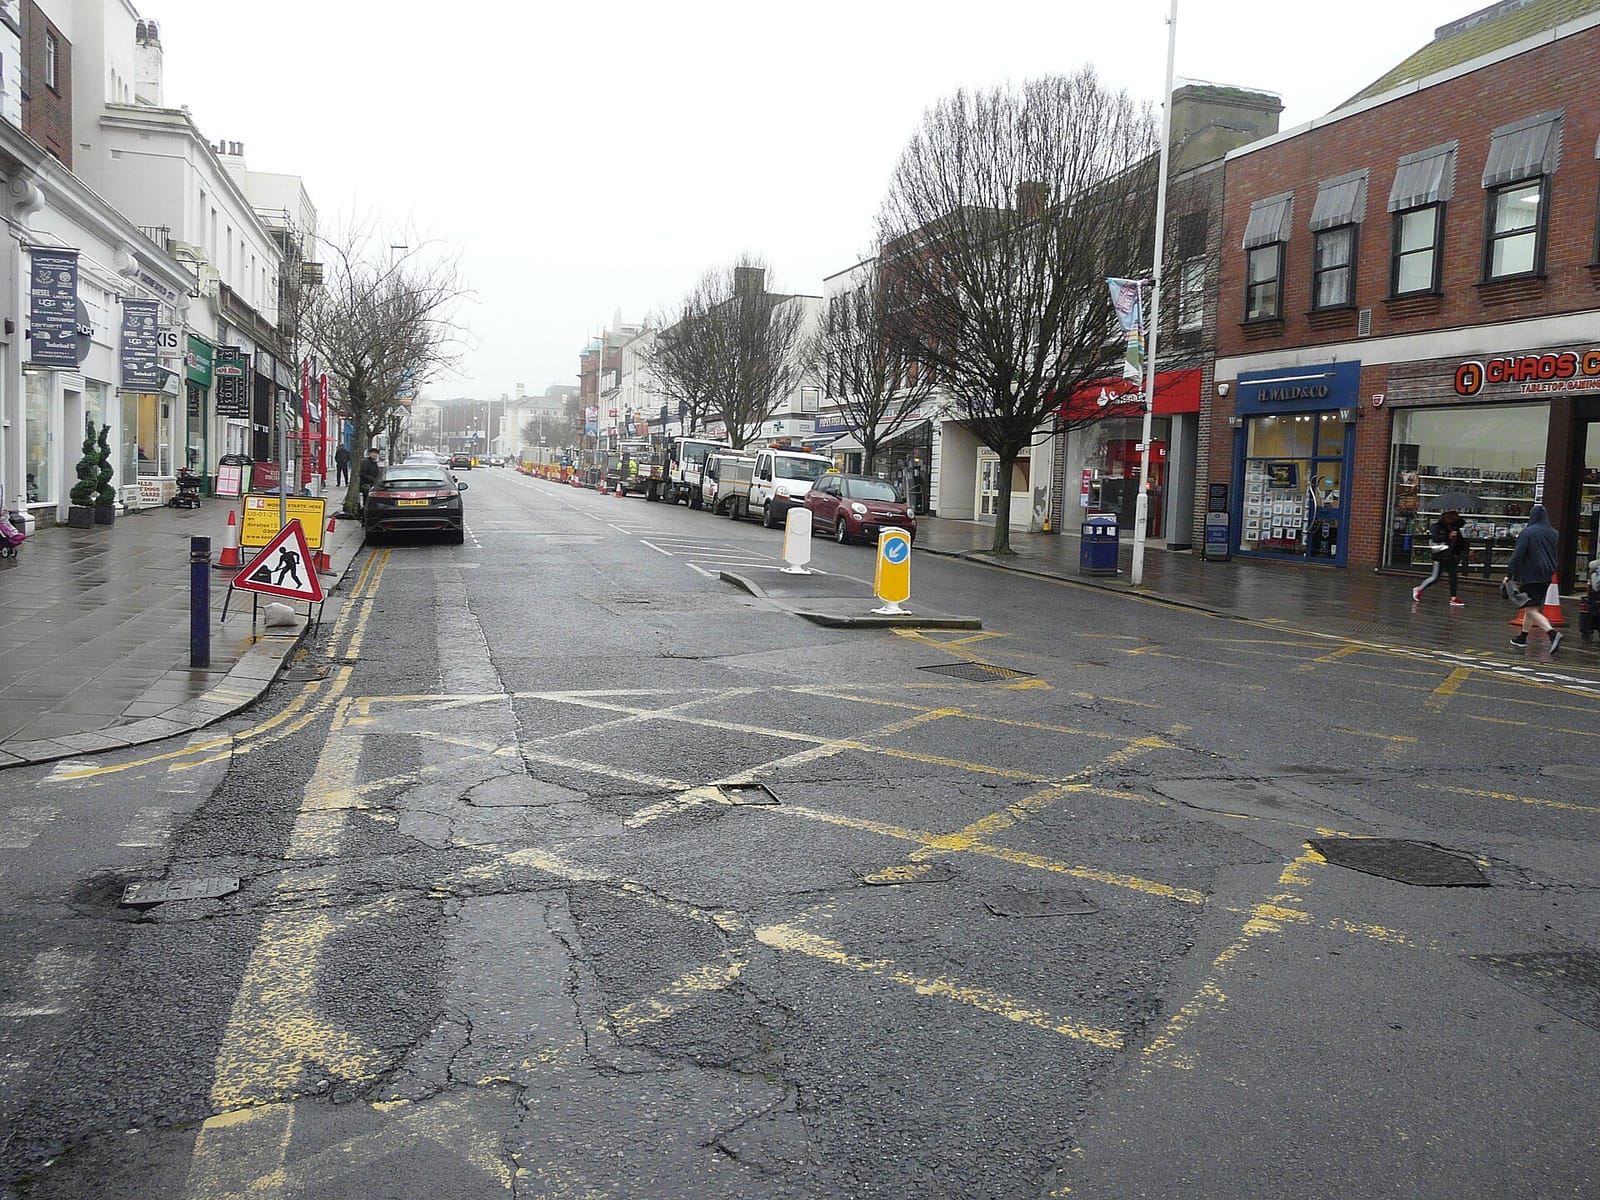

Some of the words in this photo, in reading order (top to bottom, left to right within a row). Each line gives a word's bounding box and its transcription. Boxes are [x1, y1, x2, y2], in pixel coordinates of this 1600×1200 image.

[1486, 354, 1577, 383] CHAOS
[1520, 382, 1565, 394] TABLETOP
[1566, 379, 1600, 391] GAMIN
[1340, 410, 1350, 420] W
